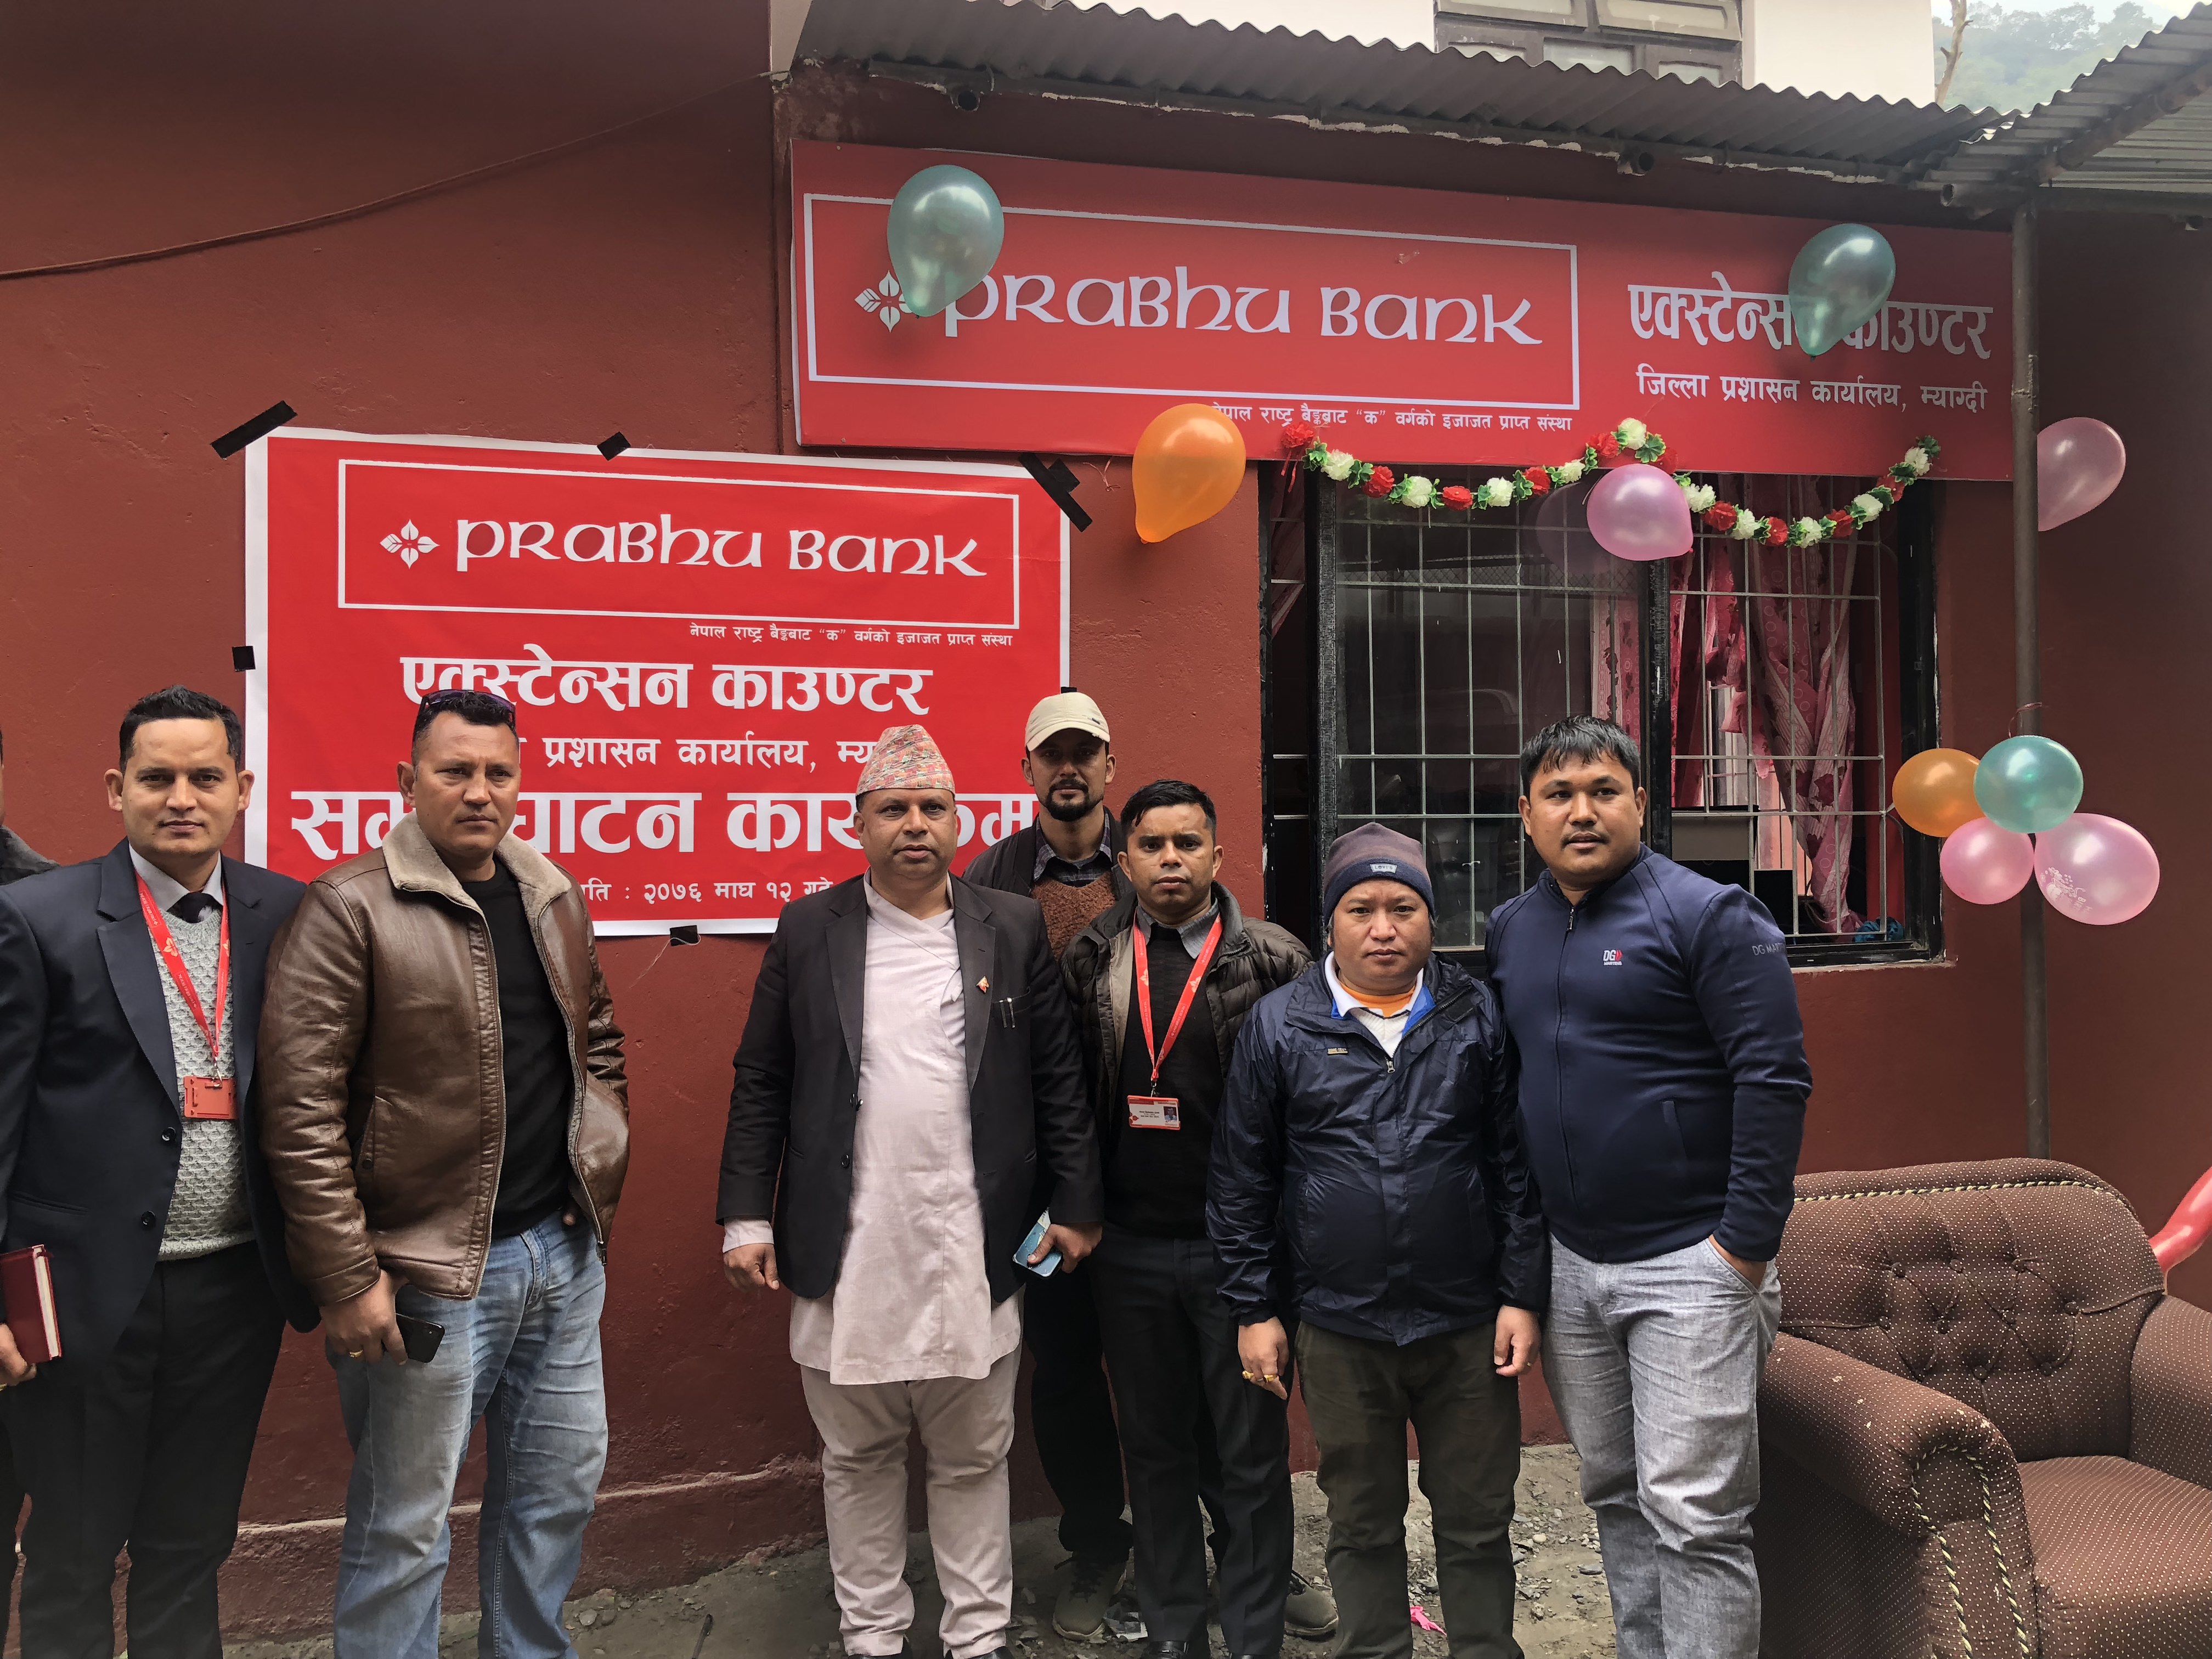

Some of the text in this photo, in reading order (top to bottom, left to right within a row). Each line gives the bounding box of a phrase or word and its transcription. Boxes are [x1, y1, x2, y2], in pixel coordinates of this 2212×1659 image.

[1627, 271, 1793, 350] एक्स्टेन्स
[1635, 363, 1710, 399] जिल्ला
[1719, 375, 1801, 403] प्रशासन
[1920, 381, 1988, 413] म्याग्दी
[1260, 407, 1294, 427] राष्ट्र
[1395, 408, 1436, 427] वर्गको
[1442, 413, 1493, 430] इजाजत
[1499, 415, 1531, 430] प्राप्त
[1537, 414, 1573, 432] संस्था
[690, 622, 727, 639] नेपाल
[732, 627, 764, 643] राष्ट्र
[854, 628, 890, 643] वर्गको
[896, 632, 942, 645] इजाजत
[947, 634, 976, 646] प्राप्त
[981, 633, 1014, 647] संस्था
[712, 664, 933, 715] काउण्टर
[542, 738, 662, 768] प्रशासन
[644, 882, 702, 905] २०७६
[713, 882, 757, 900] माघ
[766, 882, 792, 903] १२
[1752, 944, 1766, 956] DG
